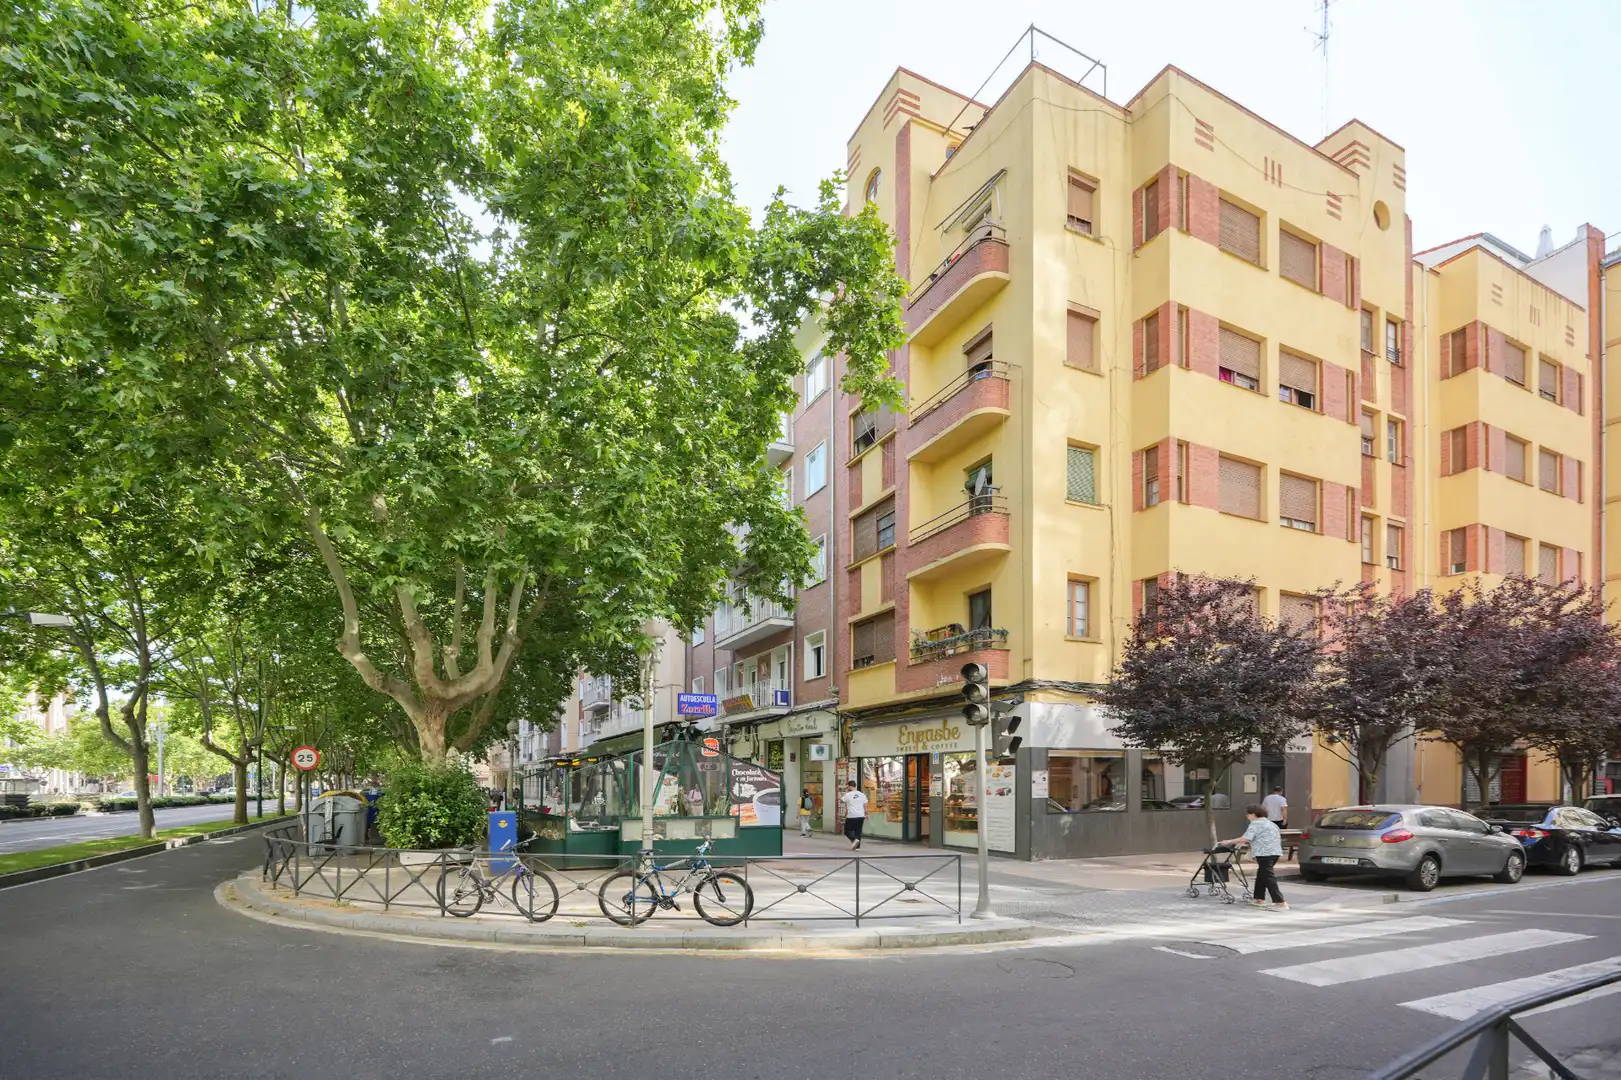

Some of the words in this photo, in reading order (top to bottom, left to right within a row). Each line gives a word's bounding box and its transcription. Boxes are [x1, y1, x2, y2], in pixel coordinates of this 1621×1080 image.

[680, 695, 716, 703] AUTOESCUELA
[778, 691, 787, 705] L
[899, 719, 960, 752] Enpasbe
[921, 741, 928, 750] &
[298, 754, 313, 762] 25
[731, 768, 761, 776] Chocolate
